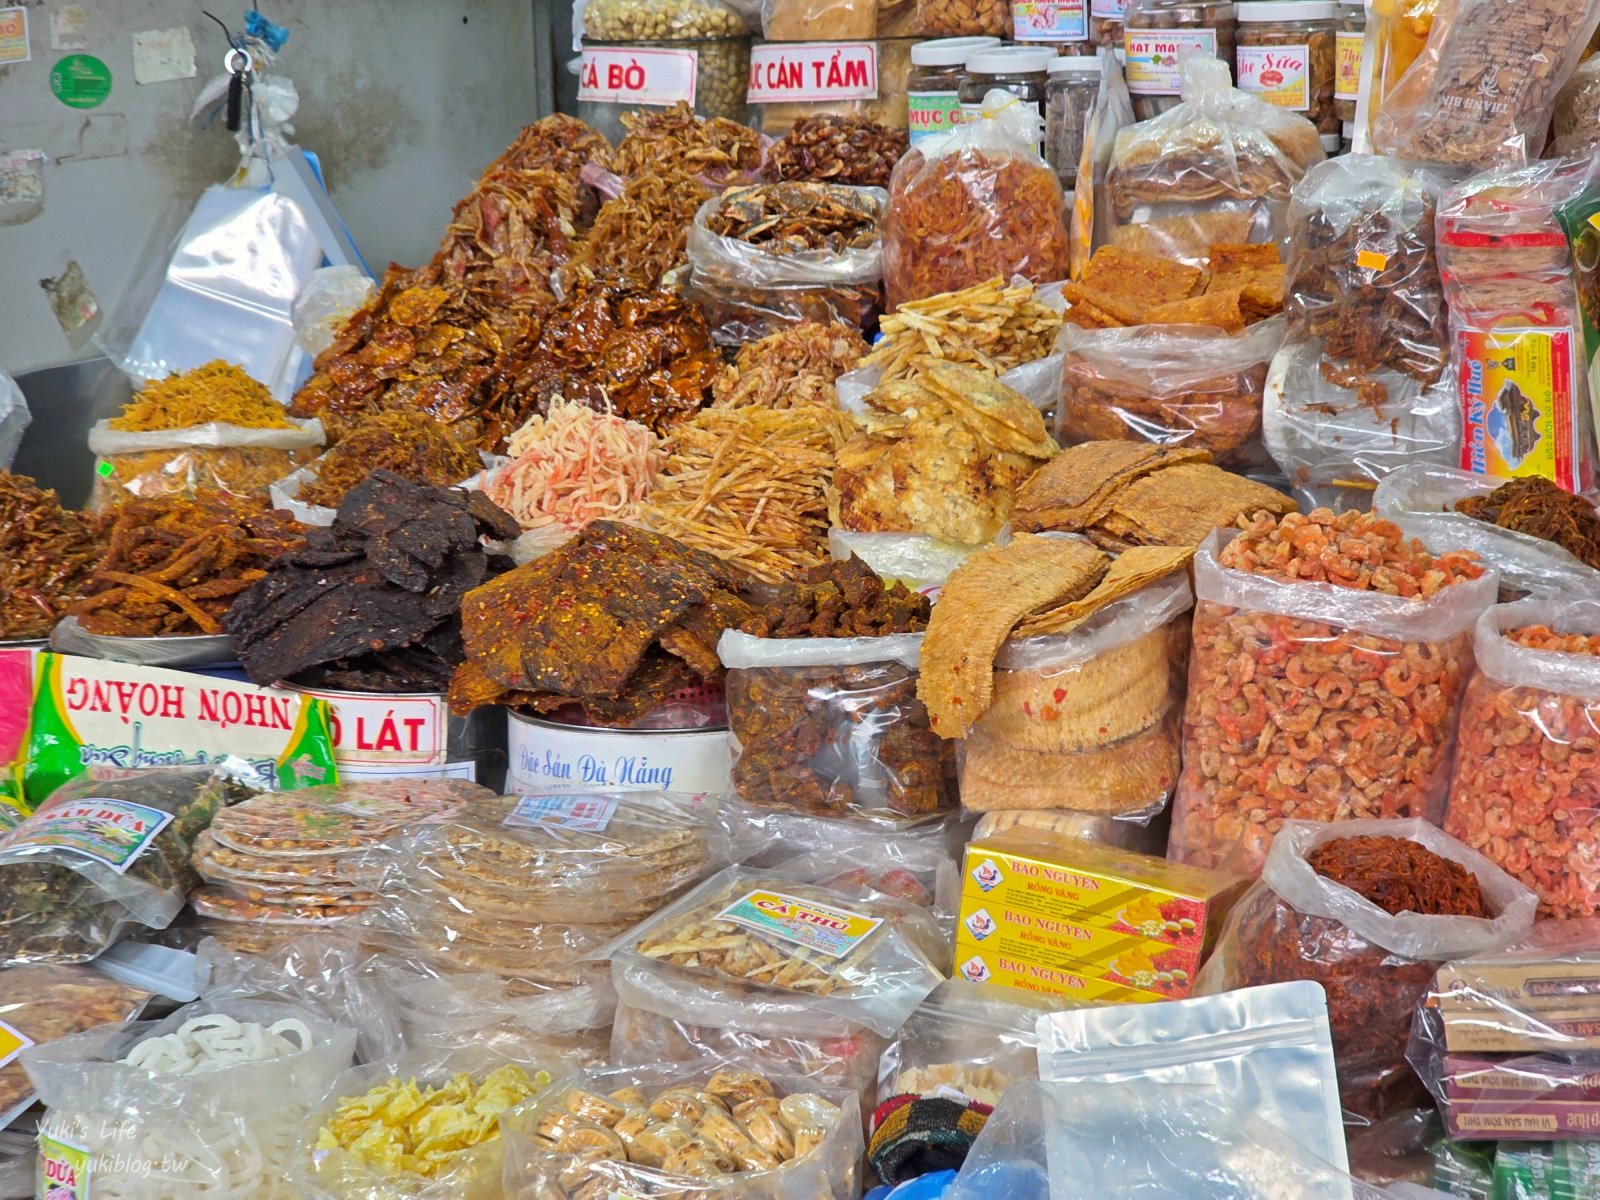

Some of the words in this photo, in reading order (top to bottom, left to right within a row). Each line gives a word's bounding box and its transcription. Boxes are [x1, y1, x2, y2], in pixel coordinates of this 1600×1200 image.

[608, 58, 646, 91] BÒ
[767, 55, 803, 89] CÁN
[812, 49, 868, 88] TẨM
[909, 109, 943, 128] MỰC
[1466, 357, 1483, 396] Huế
[66, 677, 185, 725] HOÀNG
[198, 688, 293, 730] NHƠN
[356, 709, 426, 752] LÁT
[577, 754, 608, 783] Đà
[614, 755, 673, 790] Nẵng
[797, 910, 850, 932] THU
